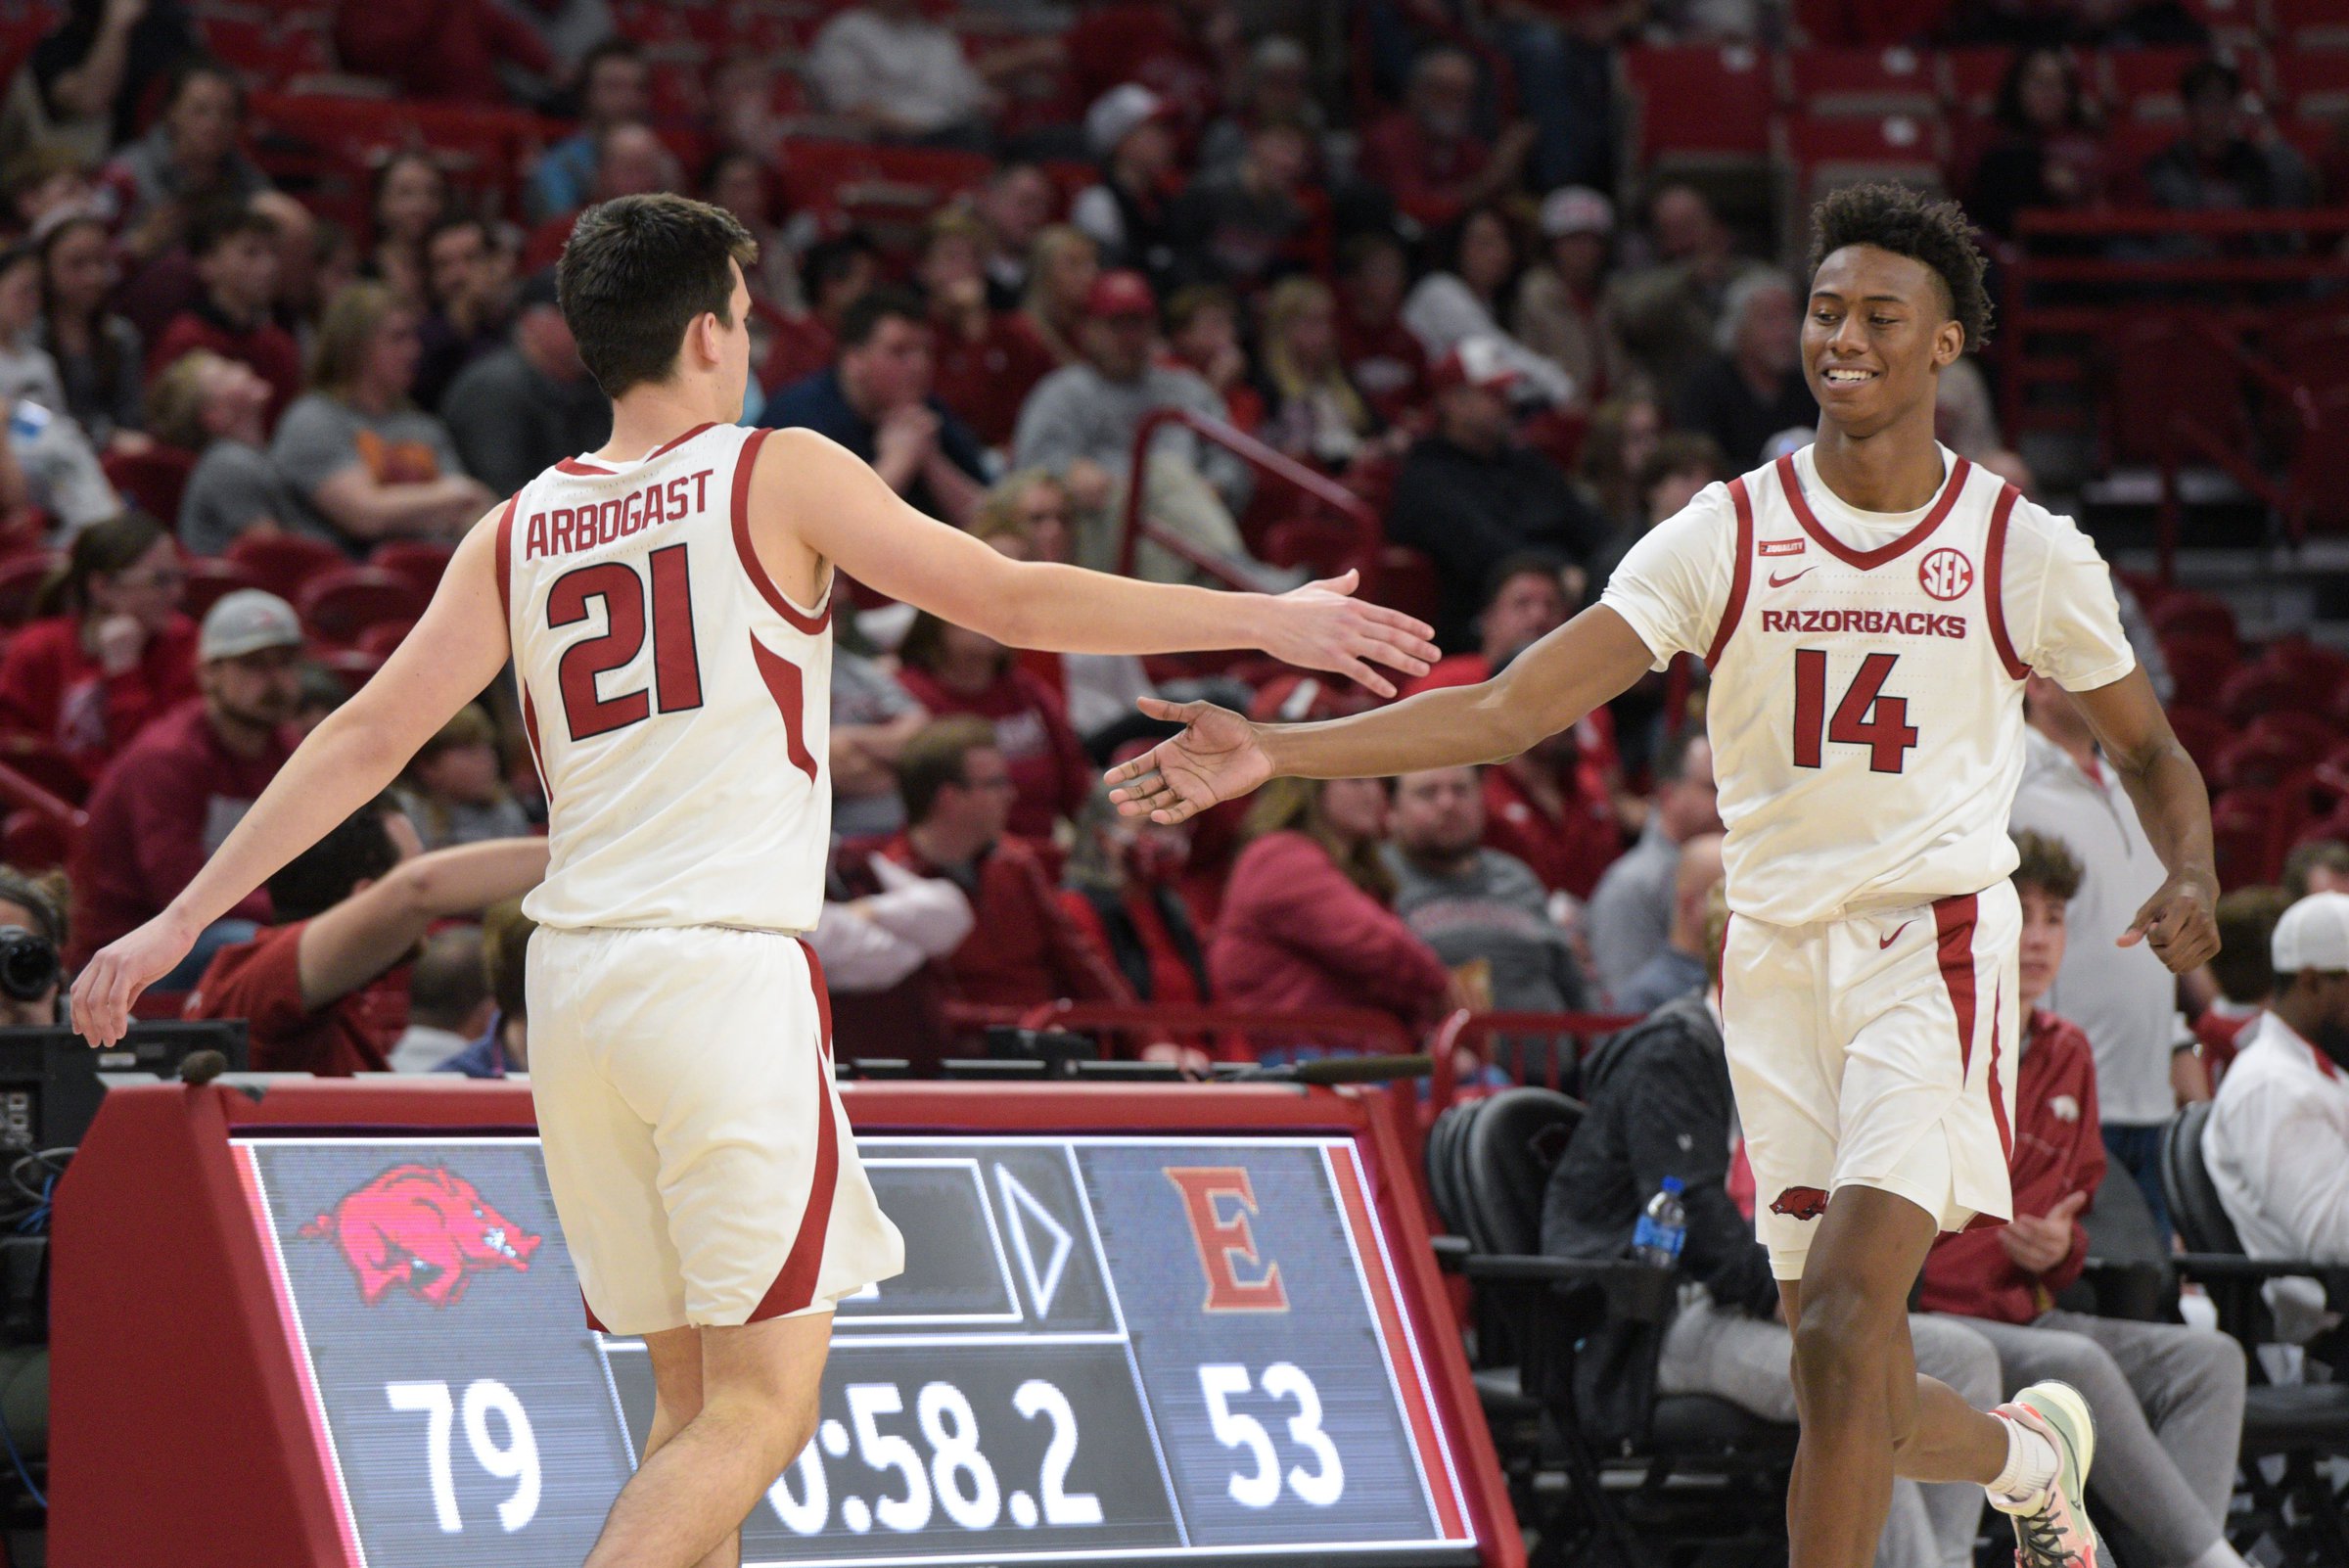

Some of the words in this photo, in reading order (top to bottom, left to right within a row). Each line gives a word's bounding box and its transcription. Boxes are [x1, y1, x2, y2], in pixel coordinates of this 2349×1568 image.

[526, 469, 714, 561] ARBOGAST
[1922, 550, 1970, 598] SEC
[546, 542, 704, 742] 21
[1762, 610, 1966, 639] RAZORBACKS
[1793, 648, 1918, 774] 14
[1162, 1166, 1291, 1314] E
[386, 1378, 542, 1535] 79
[1198, 1361, 1345, 1508] 53
